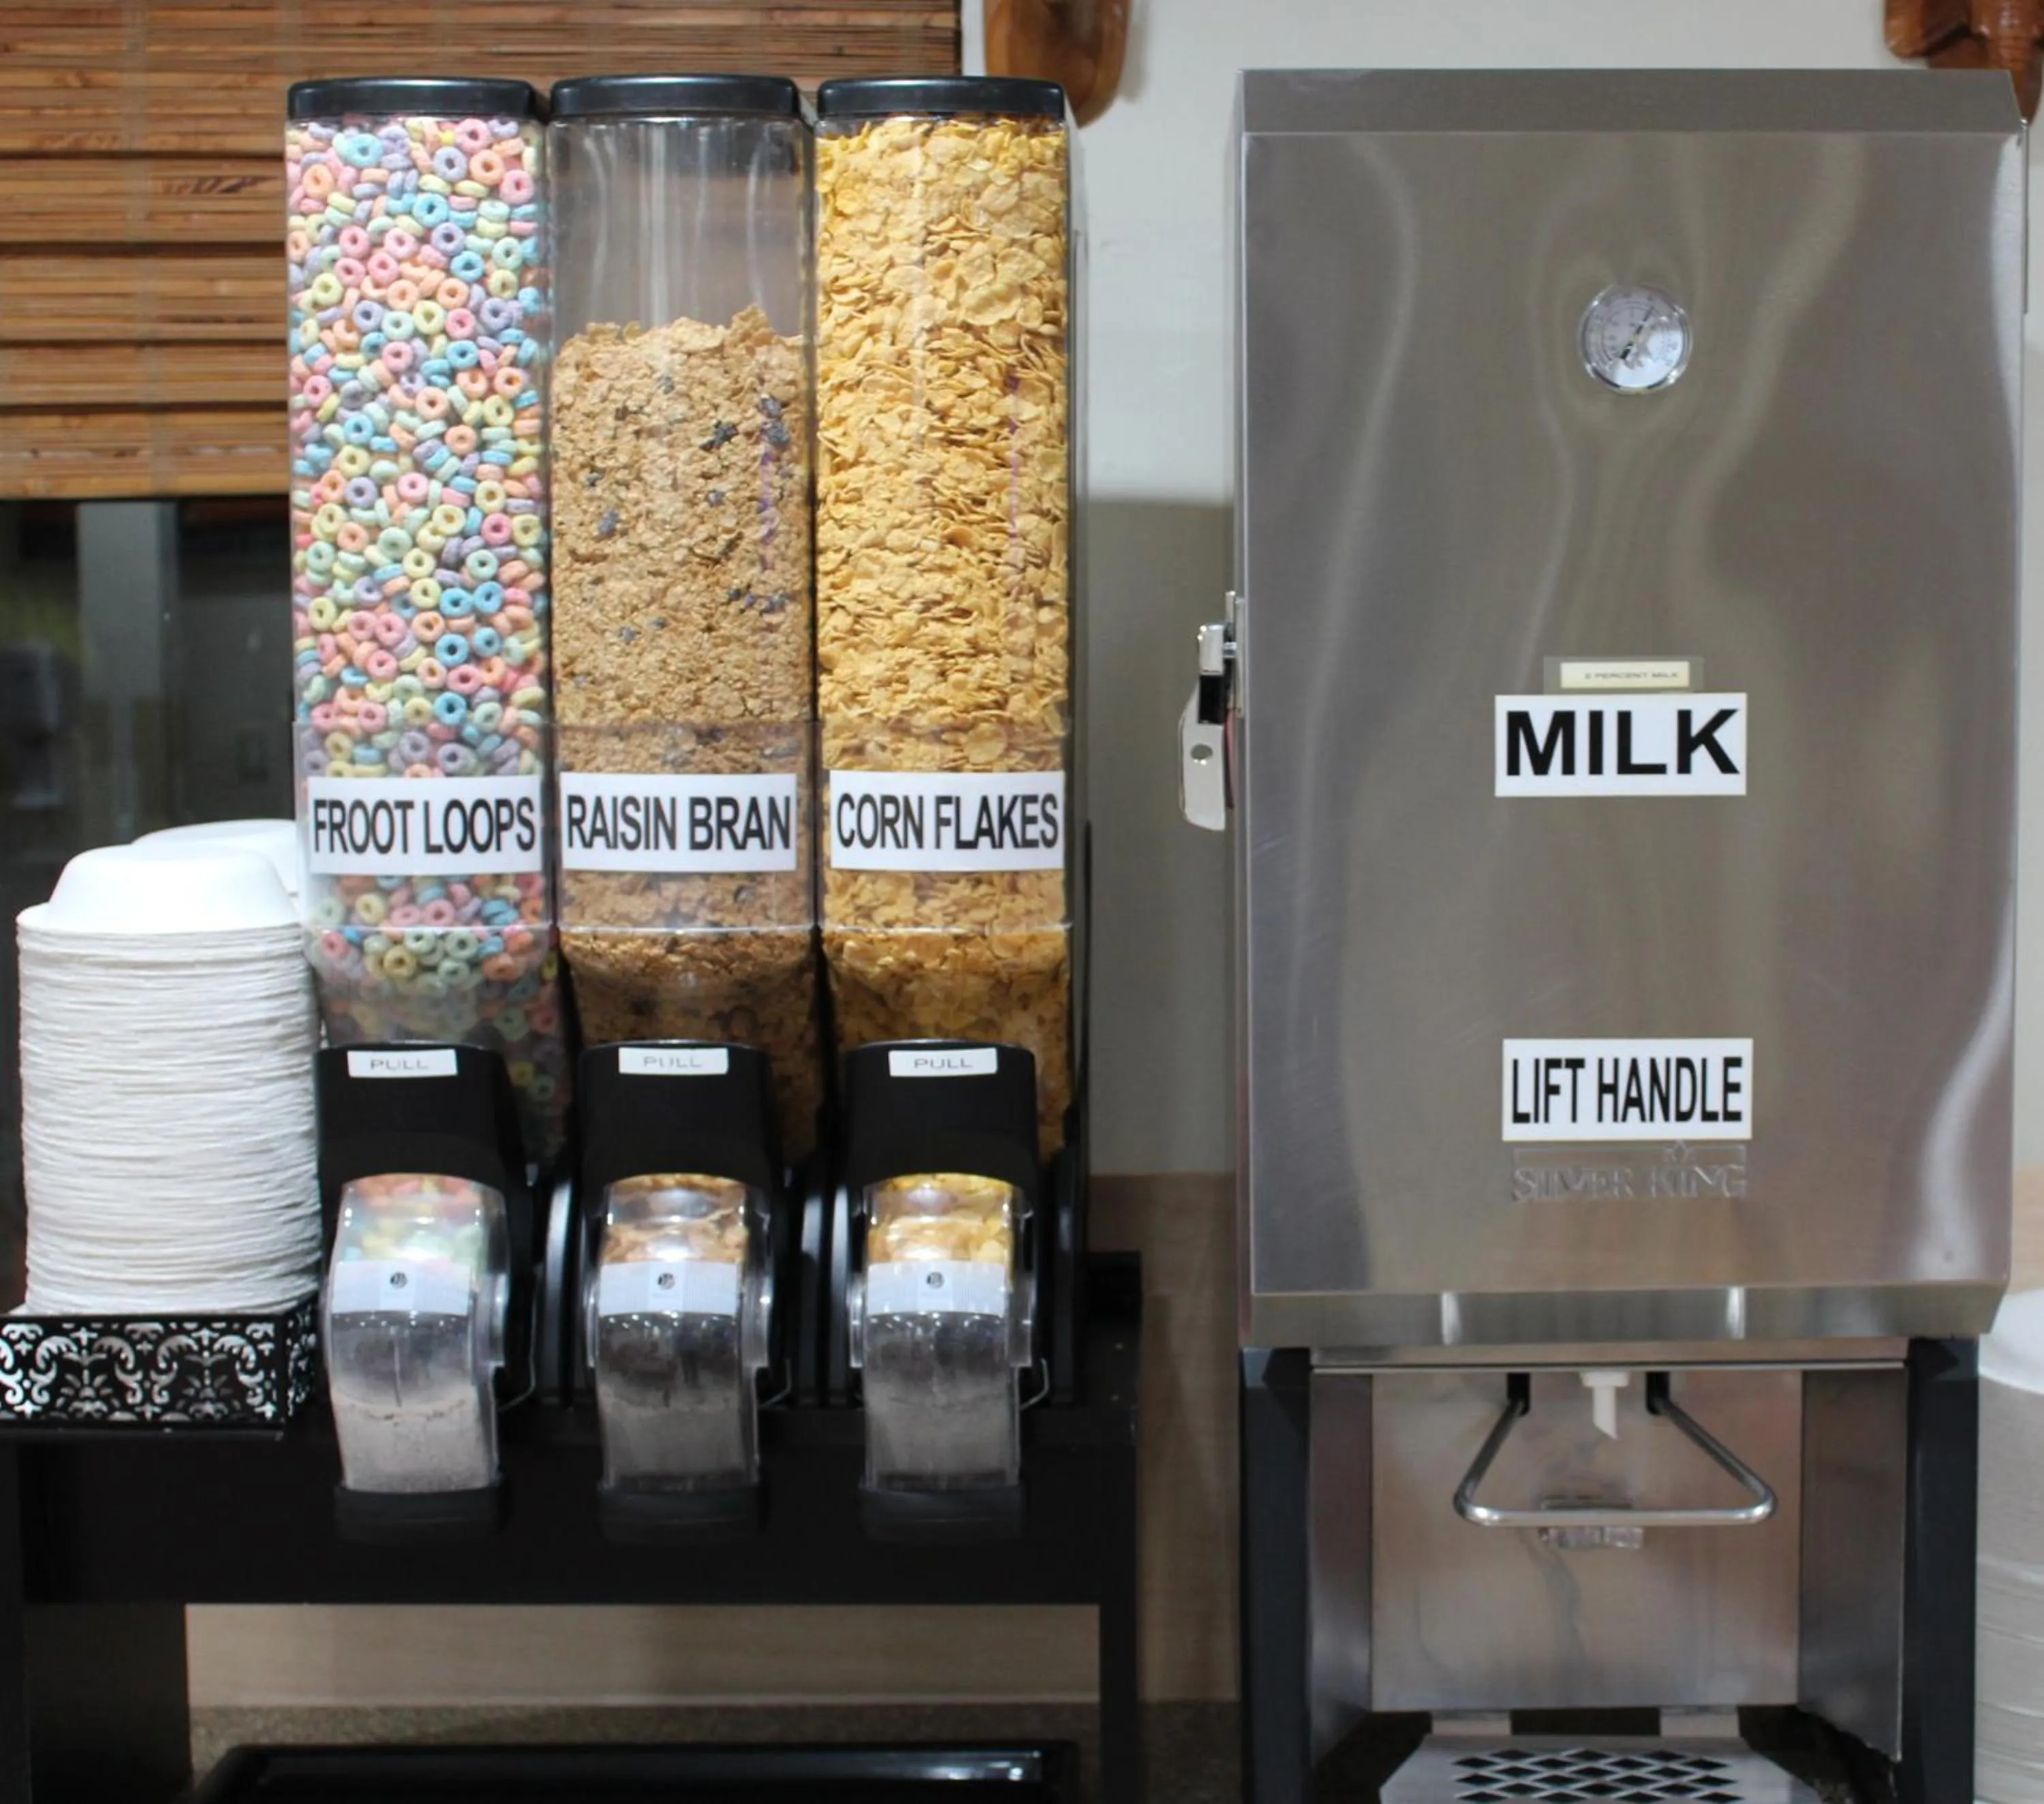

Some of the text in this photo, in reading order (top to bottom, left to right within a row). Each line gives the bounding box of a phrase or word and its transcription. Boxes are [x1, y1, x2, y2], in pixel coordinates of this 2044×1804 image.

[1506, 709, 1740, 776] MILK
[313, 796, 536, 854] FROOT LOOPS
[566, 795, 791, 850] RAISIN BRAN
[836, 793, 1059, 849] CORN FLAKES
[371, 1058, 429, 1070] PULL
[643, 1056, 702, 1068] PULL
[914, 1057, 973, 1070] PULL
[1512, 1057, 1743, 1123] LIFT HANDLE
[1512, 1164, 1747, 1200] SILVER KING
